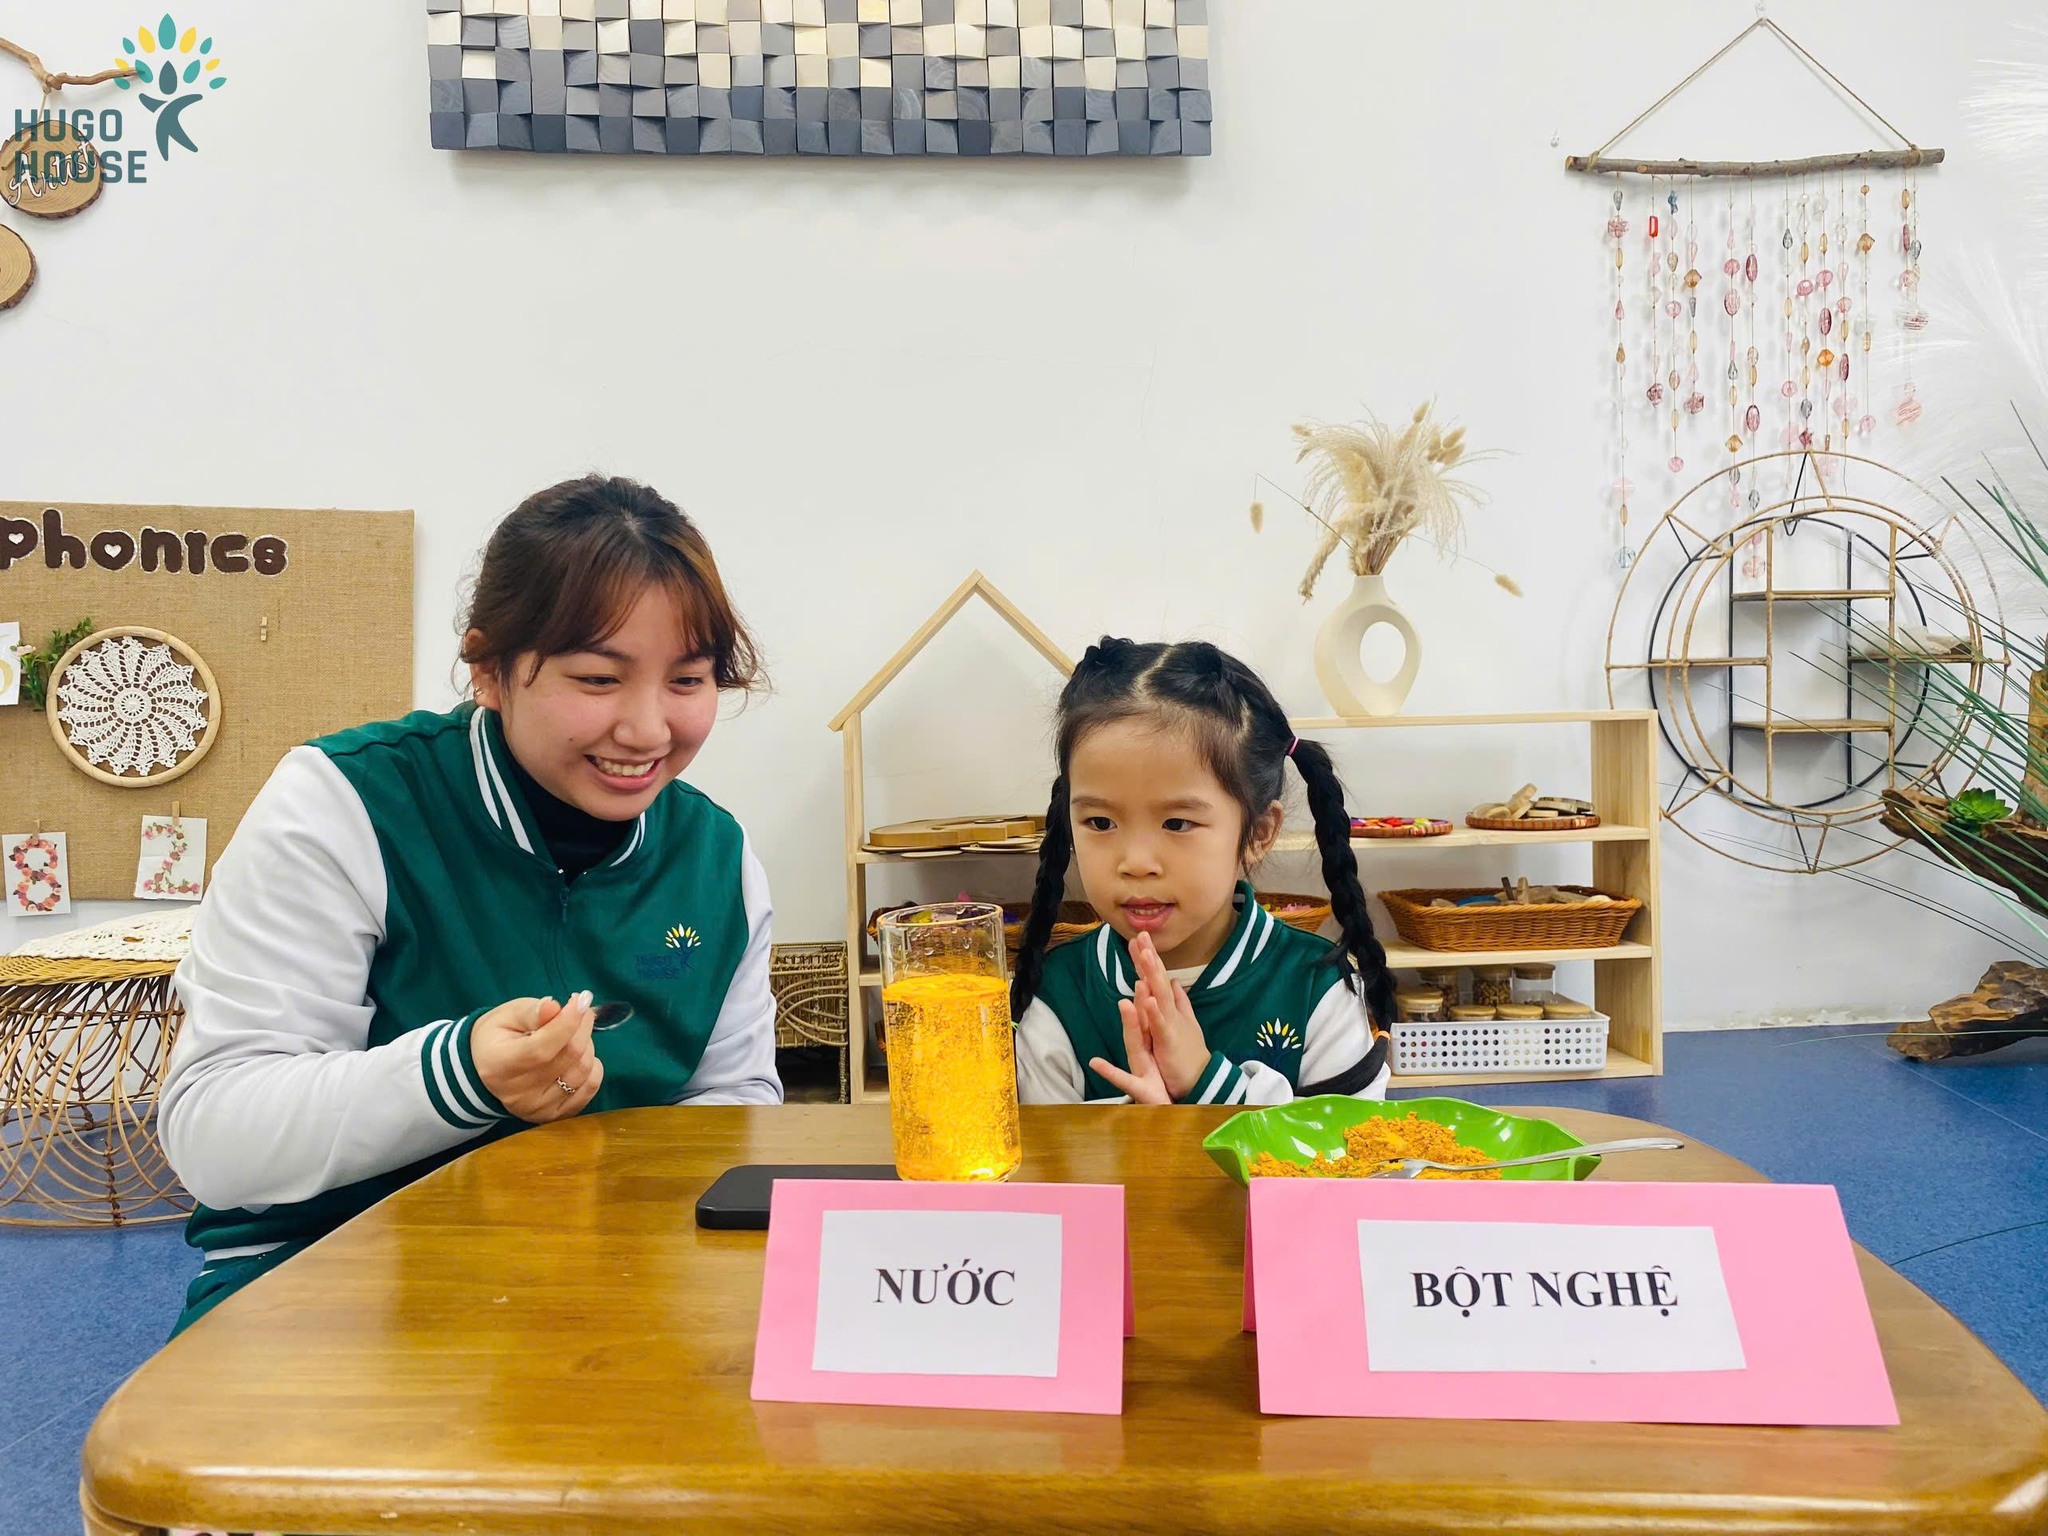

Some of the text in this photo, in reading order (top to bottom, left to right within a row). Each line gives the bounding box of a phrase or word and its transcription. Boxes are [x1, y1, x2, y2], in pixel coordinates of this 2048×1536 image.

[9, 837, 62, 912] 8
[142, 821, 201, 895] 2
[872, 1258, 1016, 1306] NƯỚC
[1410, 1265, 1678, 1318] BỘT NGHỆ
